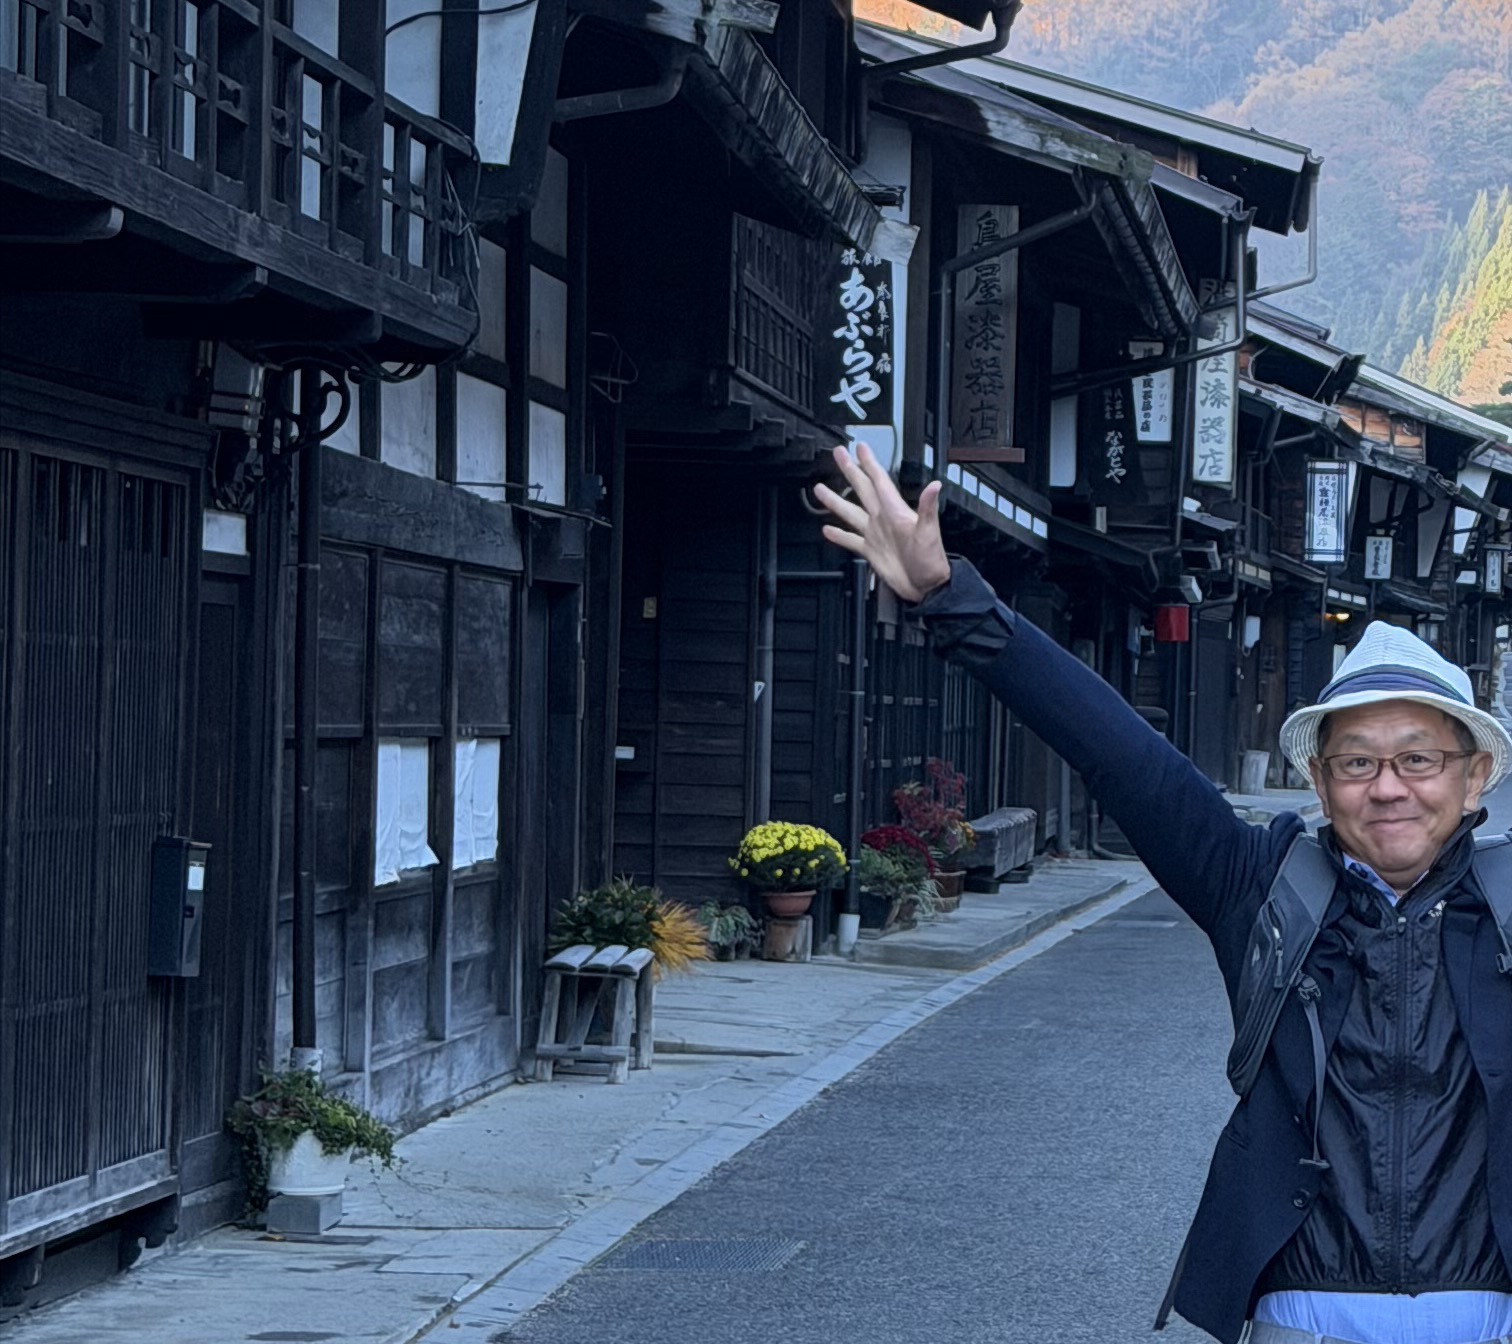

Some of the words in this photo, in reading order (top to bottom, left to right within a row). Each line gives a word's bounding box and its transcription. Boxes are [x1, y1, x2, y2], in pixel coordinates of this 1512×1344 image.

[829, 266, 882, 421] あぶらや
[1105, 430, 1127, 484] ながとや
